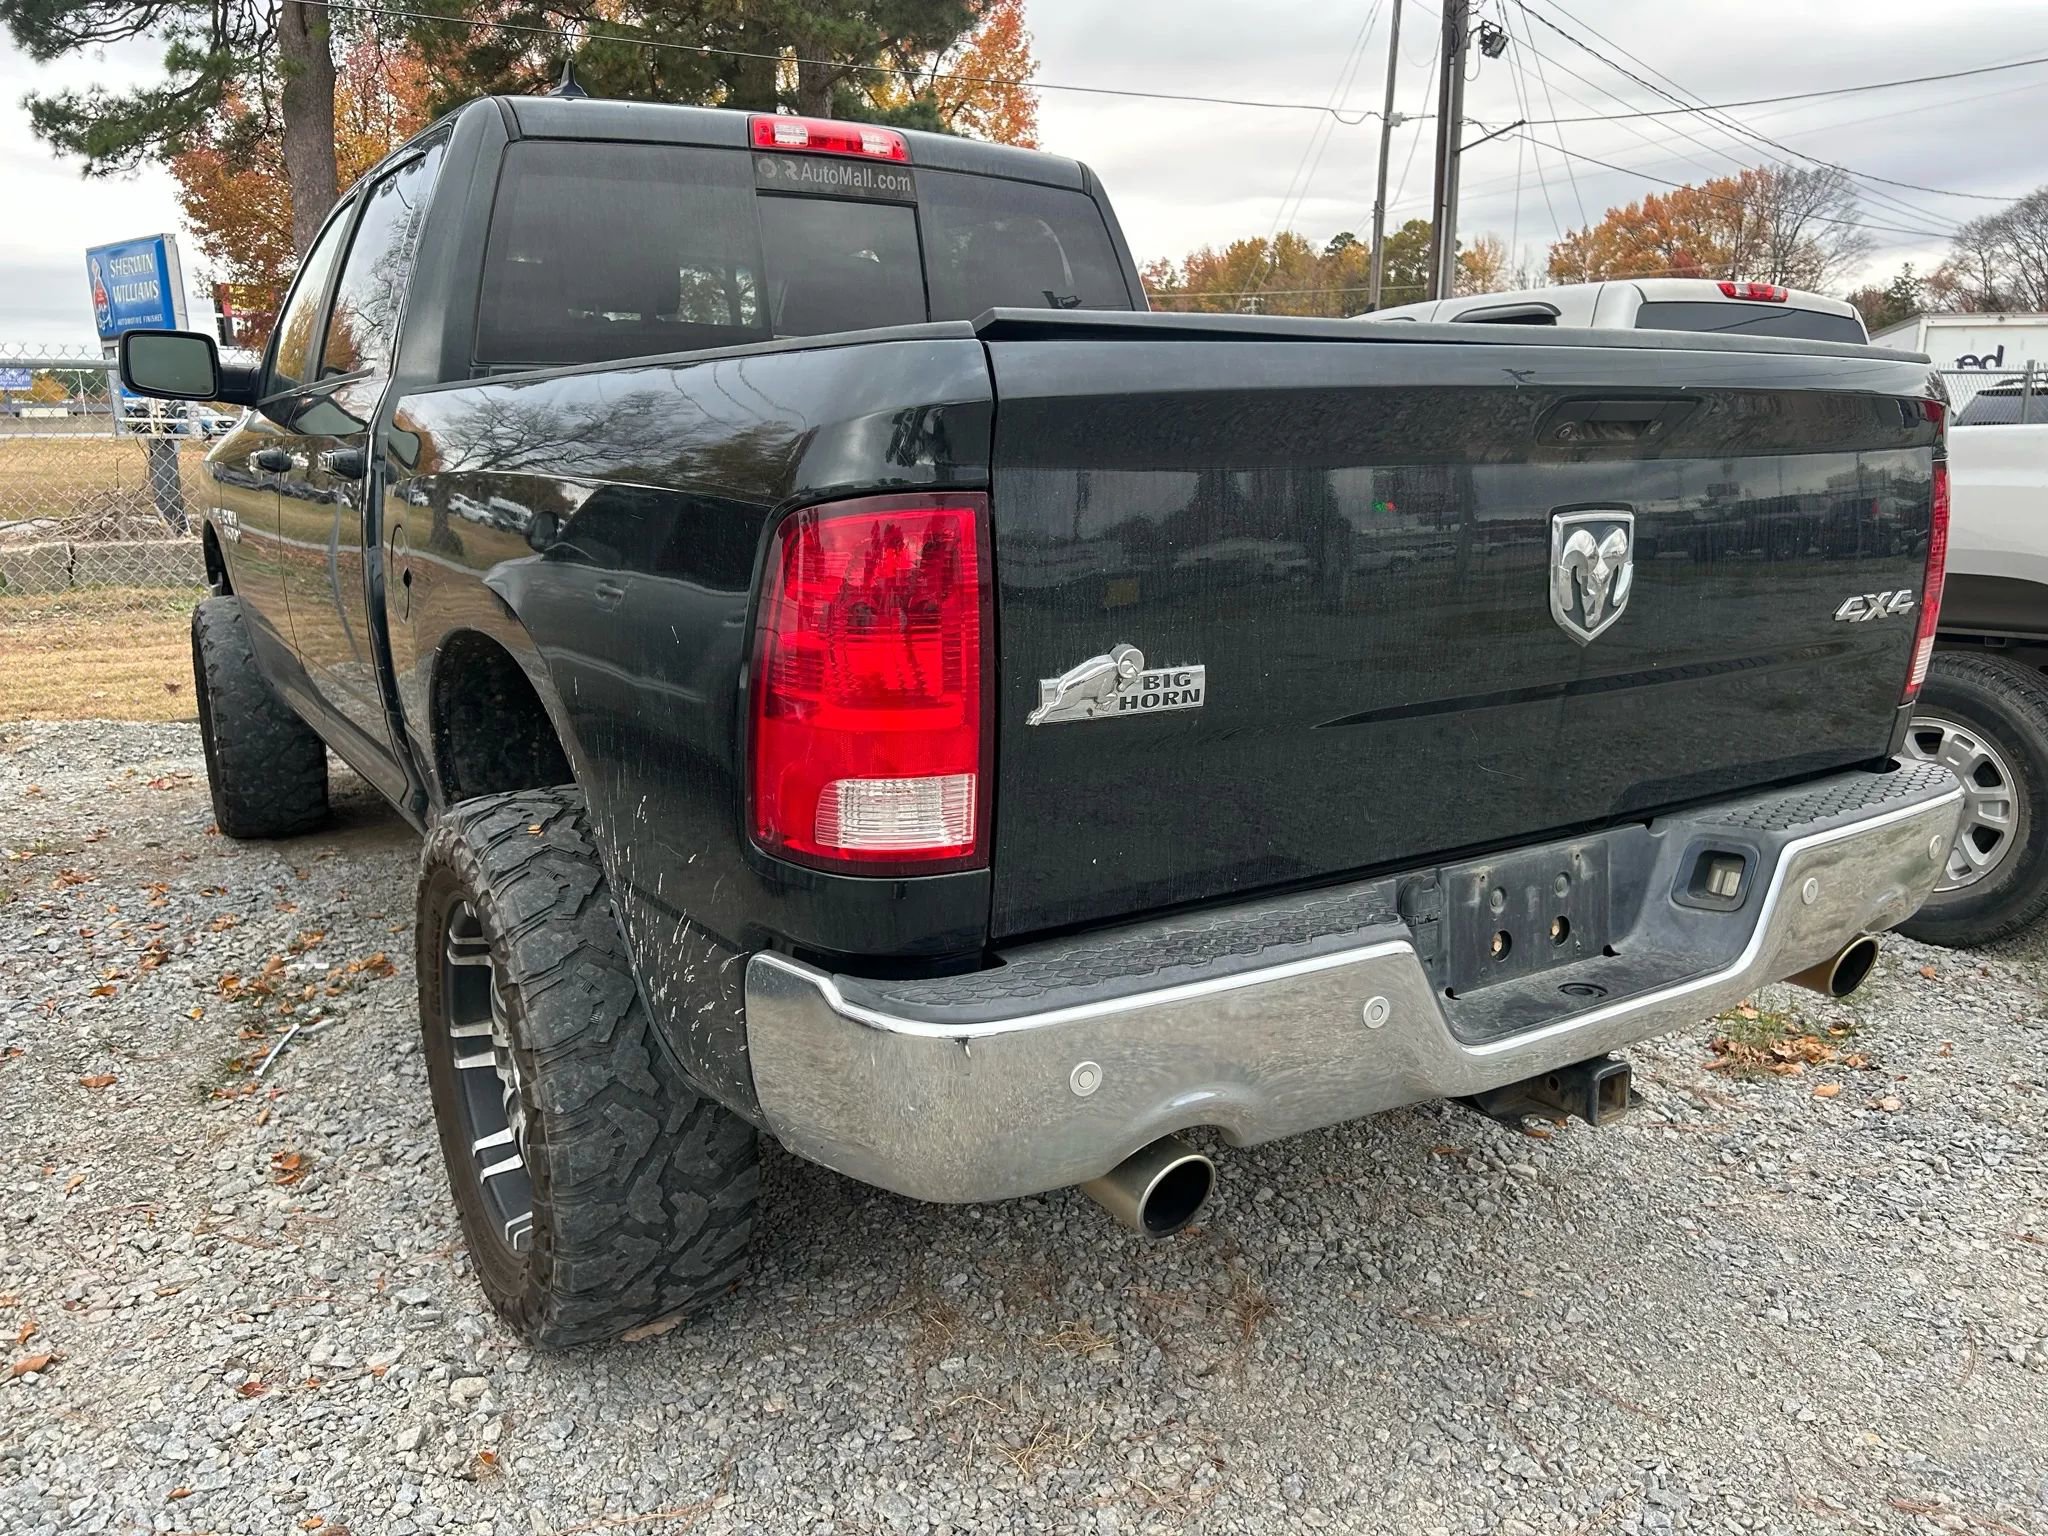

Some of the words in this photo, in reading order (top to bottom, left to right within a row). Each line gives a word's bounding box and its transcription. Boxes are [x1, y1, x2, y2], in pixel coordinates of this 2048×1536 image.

[110, 253, 154, 278] SHERWIN
[112, 280, 159, 304] WILLIAMS
[1143, 672, 1191, 691] BIG
[1119, 689, 1200, 711] HORN
